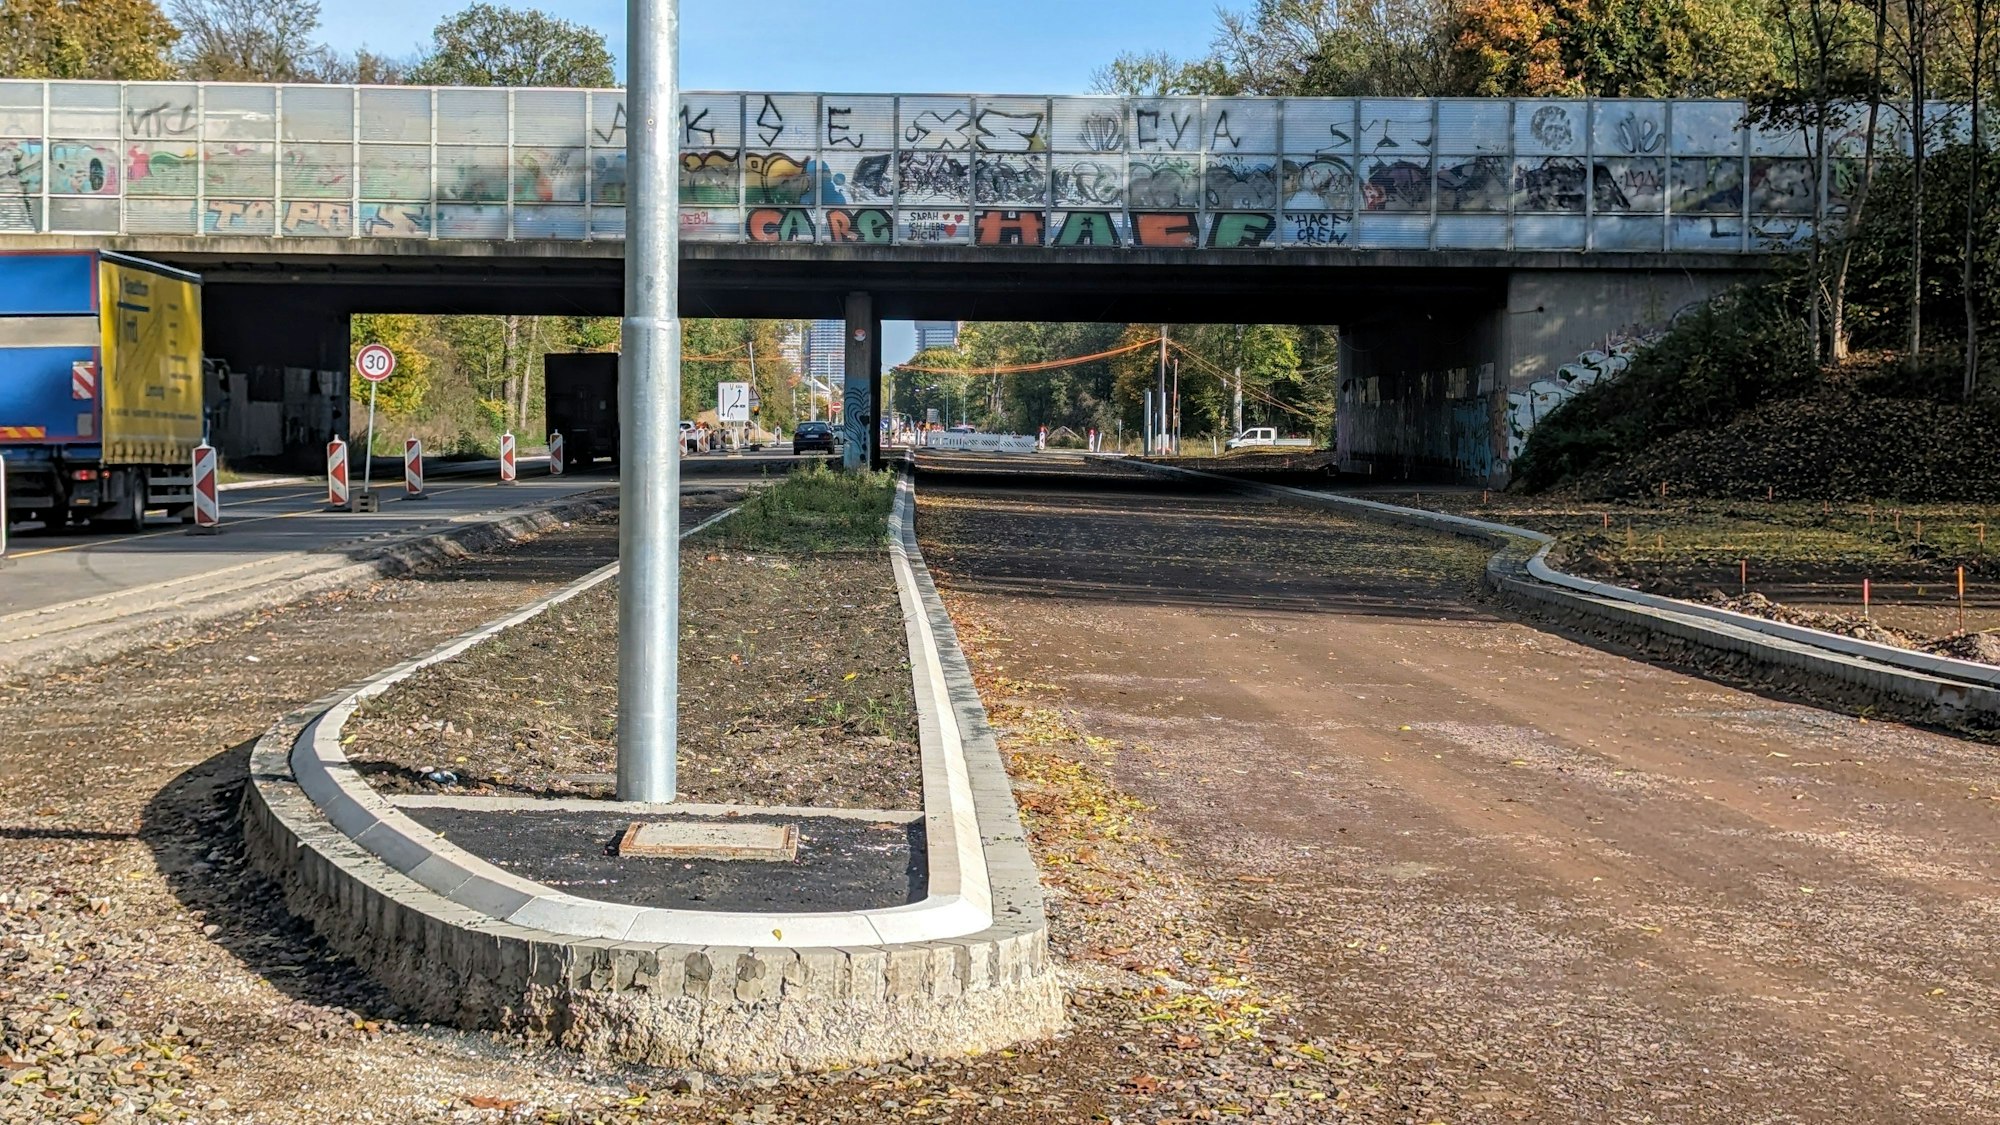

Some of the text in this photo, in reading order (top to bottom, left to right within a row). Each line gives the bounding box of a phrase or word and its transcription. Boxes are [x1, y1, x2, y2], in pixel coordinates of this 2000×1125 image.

[910, 230, 940, 241] DICH!
[1297, 226, 1348, 245] CREW
[365, 354, 386, 370] 30
